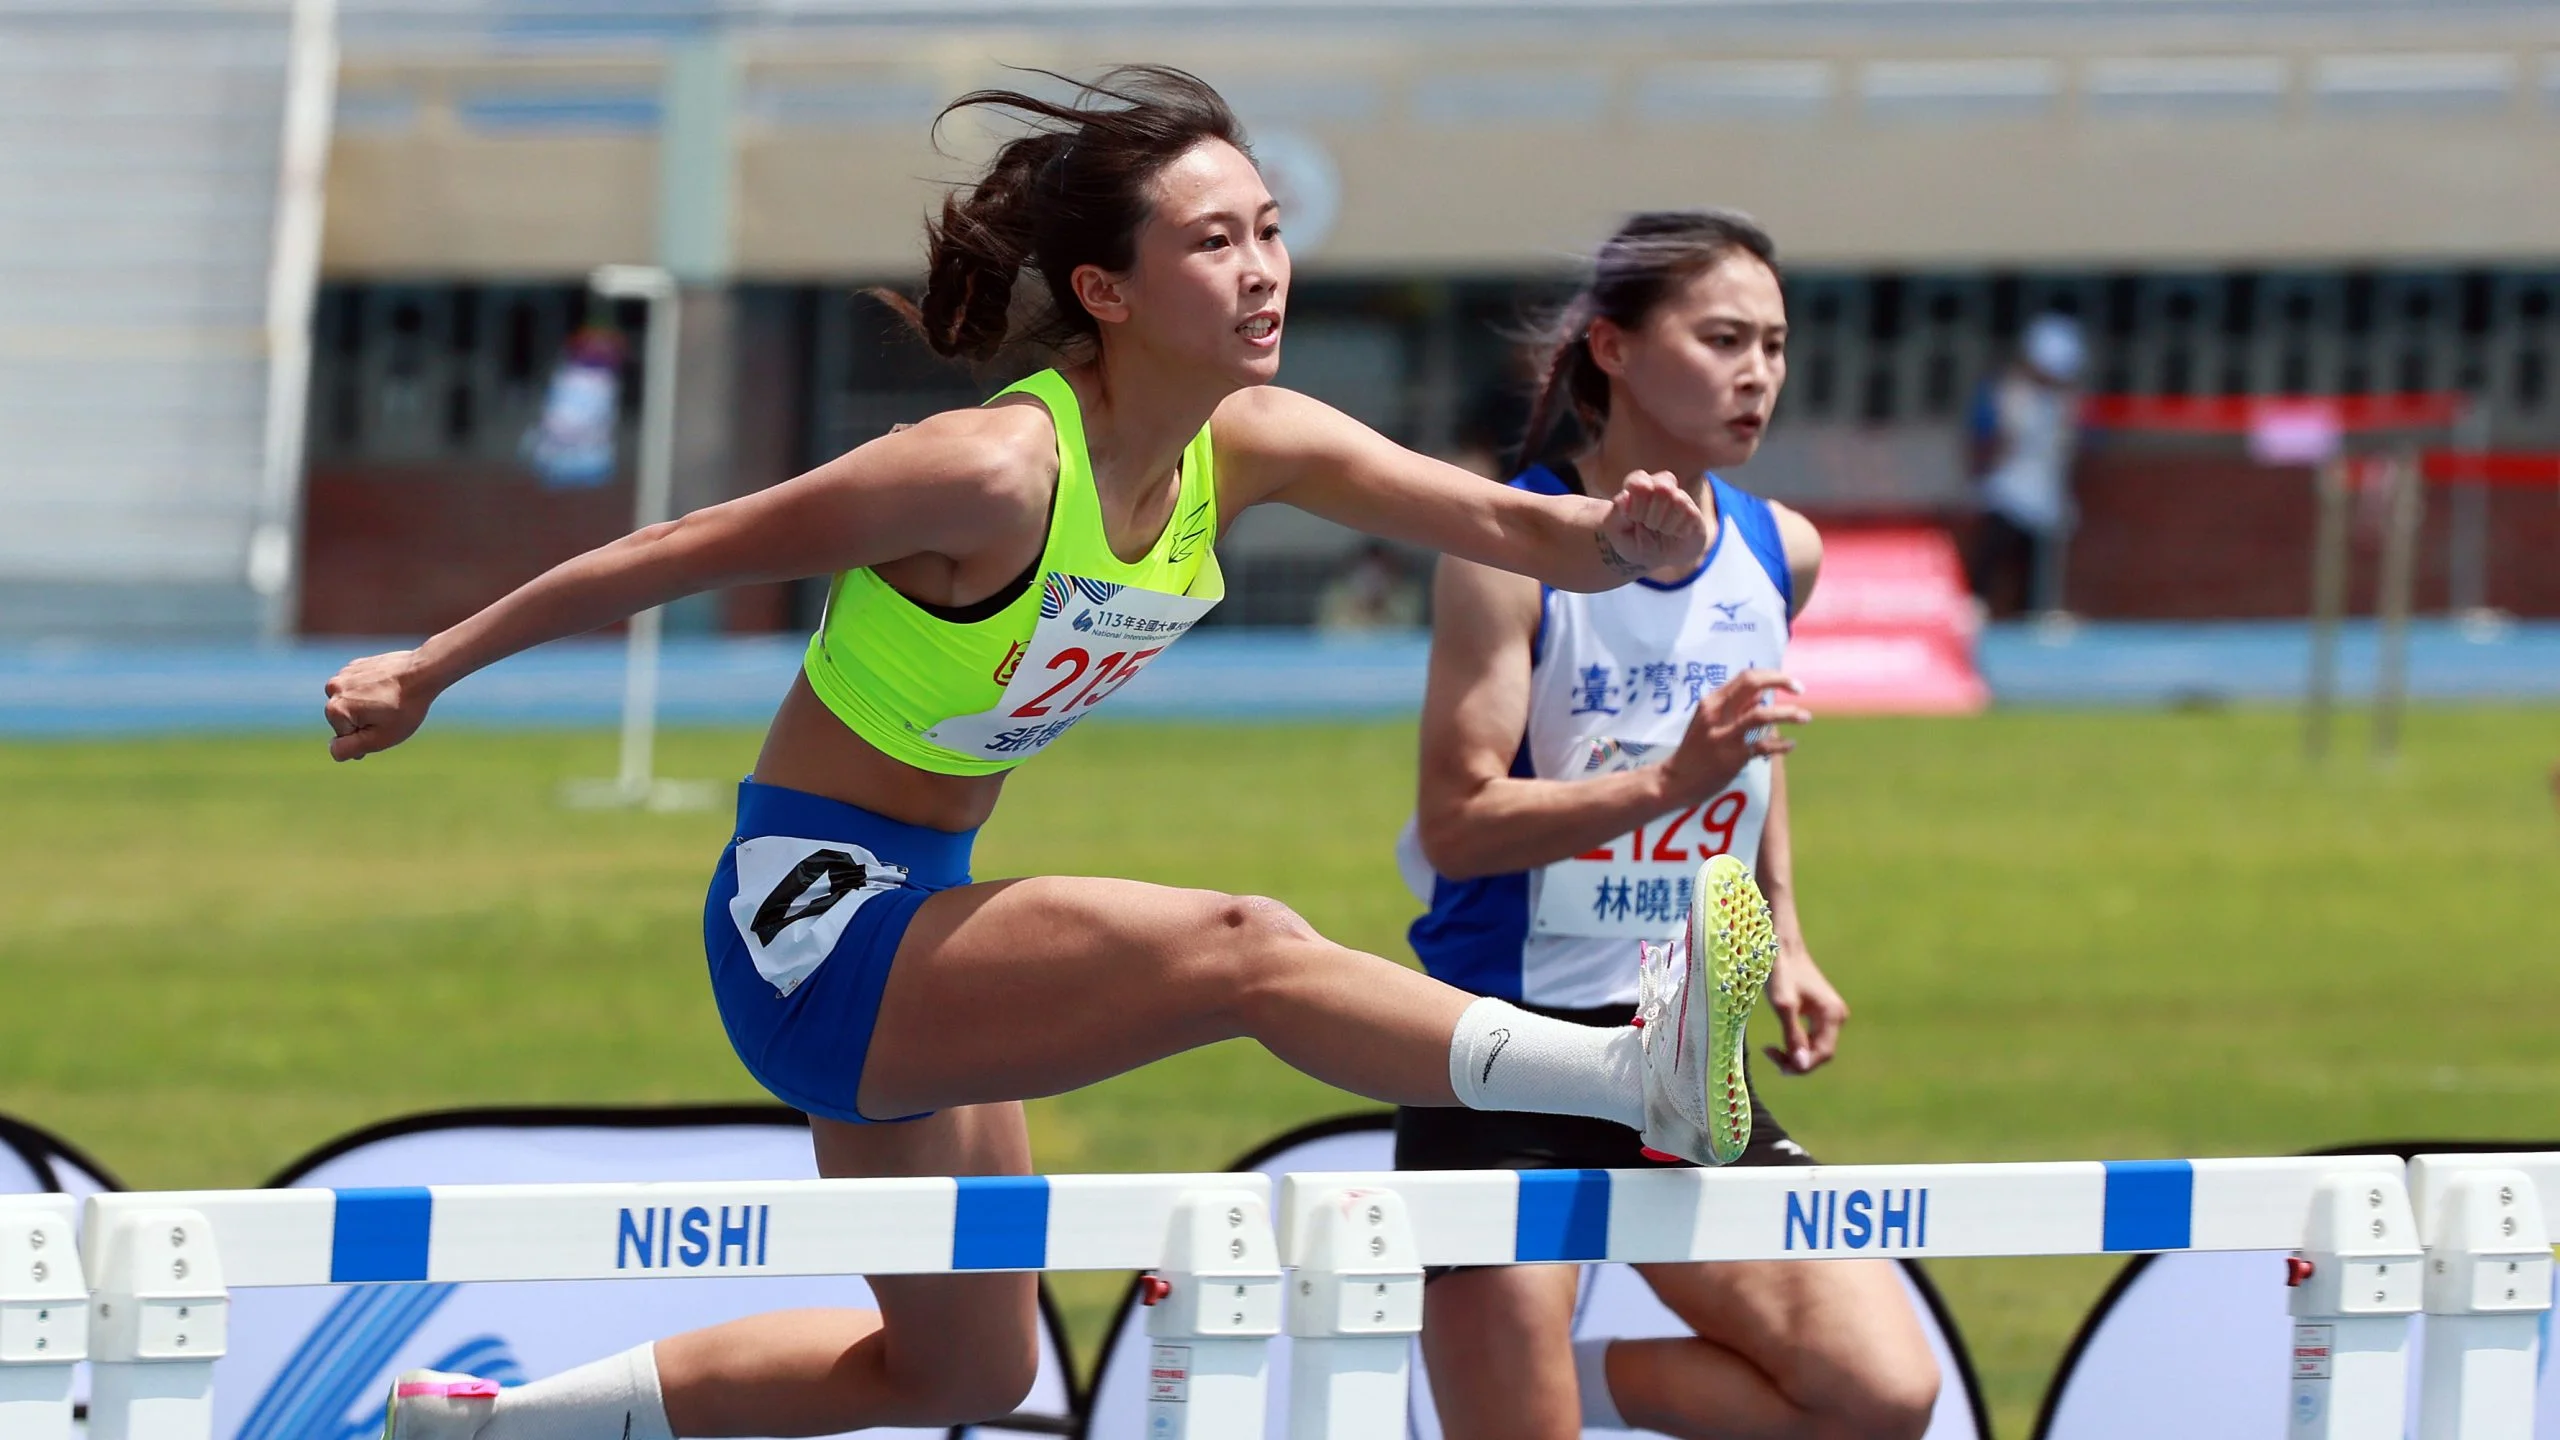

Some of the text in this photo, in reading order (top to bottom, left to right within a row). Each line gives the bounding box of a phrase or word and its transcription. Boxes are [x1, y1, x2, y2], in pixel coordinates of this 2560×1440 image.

[1091, 628, 1121, 639] National
[1008, 643, 1164, 718] 215
[1571, 660, 1768, 716] 臺灣體
[616, 1204, 769, 1269] NISHI
[1785, 1188, 1928, 1250] NISHI
